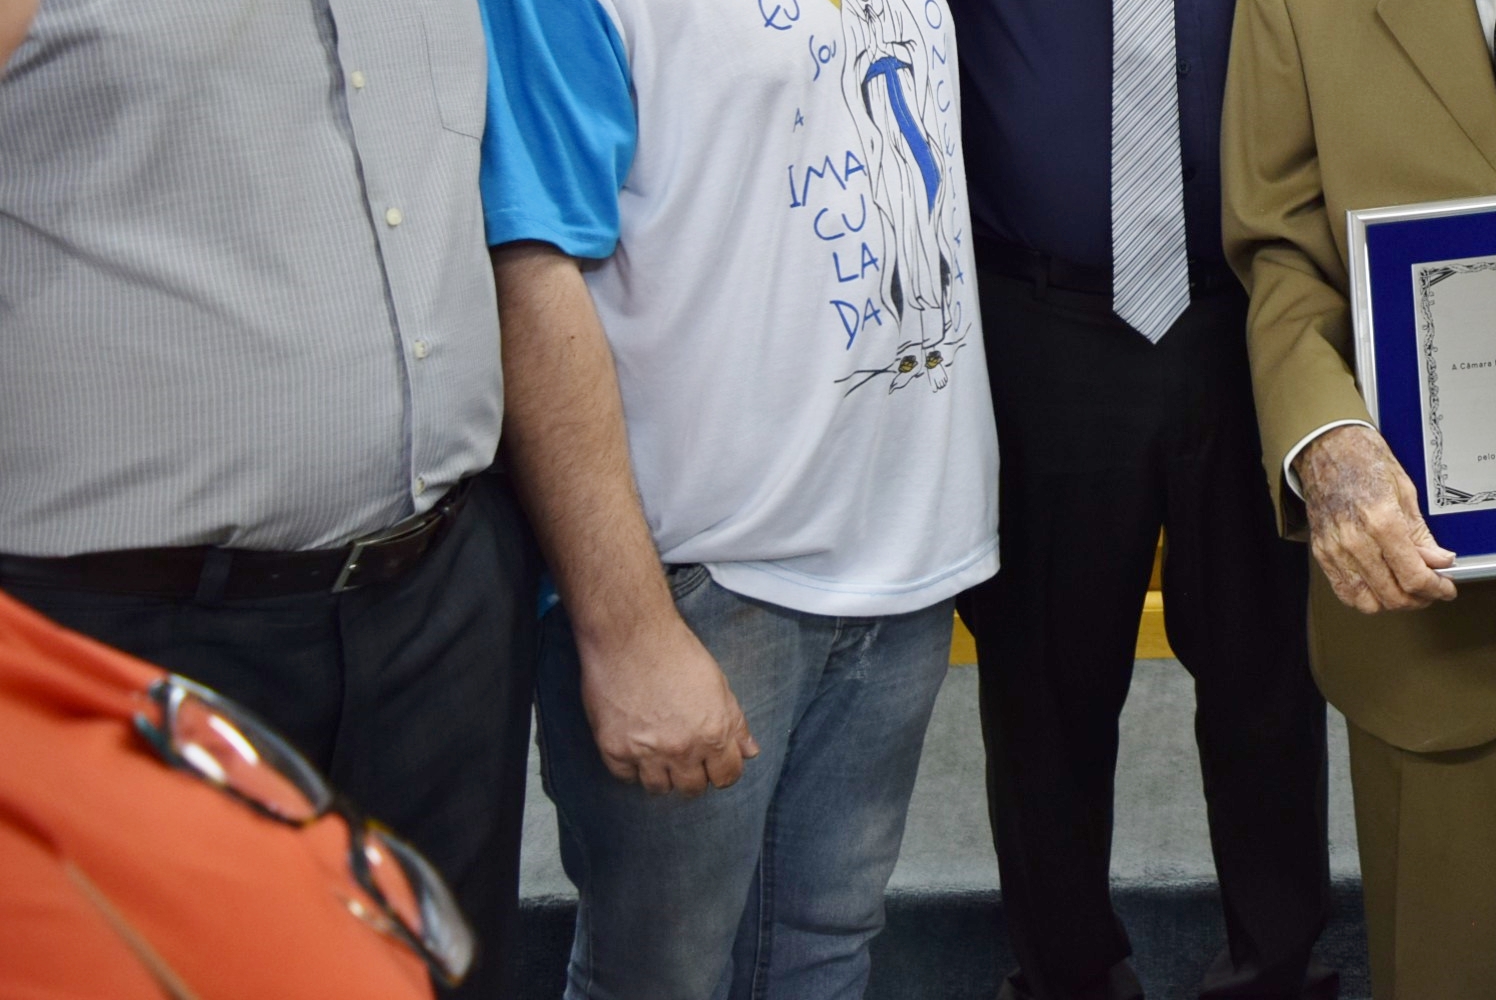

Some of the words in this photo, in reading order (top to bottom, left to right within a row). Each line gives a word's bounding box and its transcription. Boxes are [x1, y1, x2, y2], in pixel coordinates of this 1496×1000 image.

[792, 108, 804, 132] A
[787, 149, 868, 208] IMA
[814, 193, 867, 241] CU
[833, 242, 880, 283] LA
[830, 297, 883, 351] DA
[1451, 363, 1458, 371] A
[1460, 360, 1493, 370] Câmara
